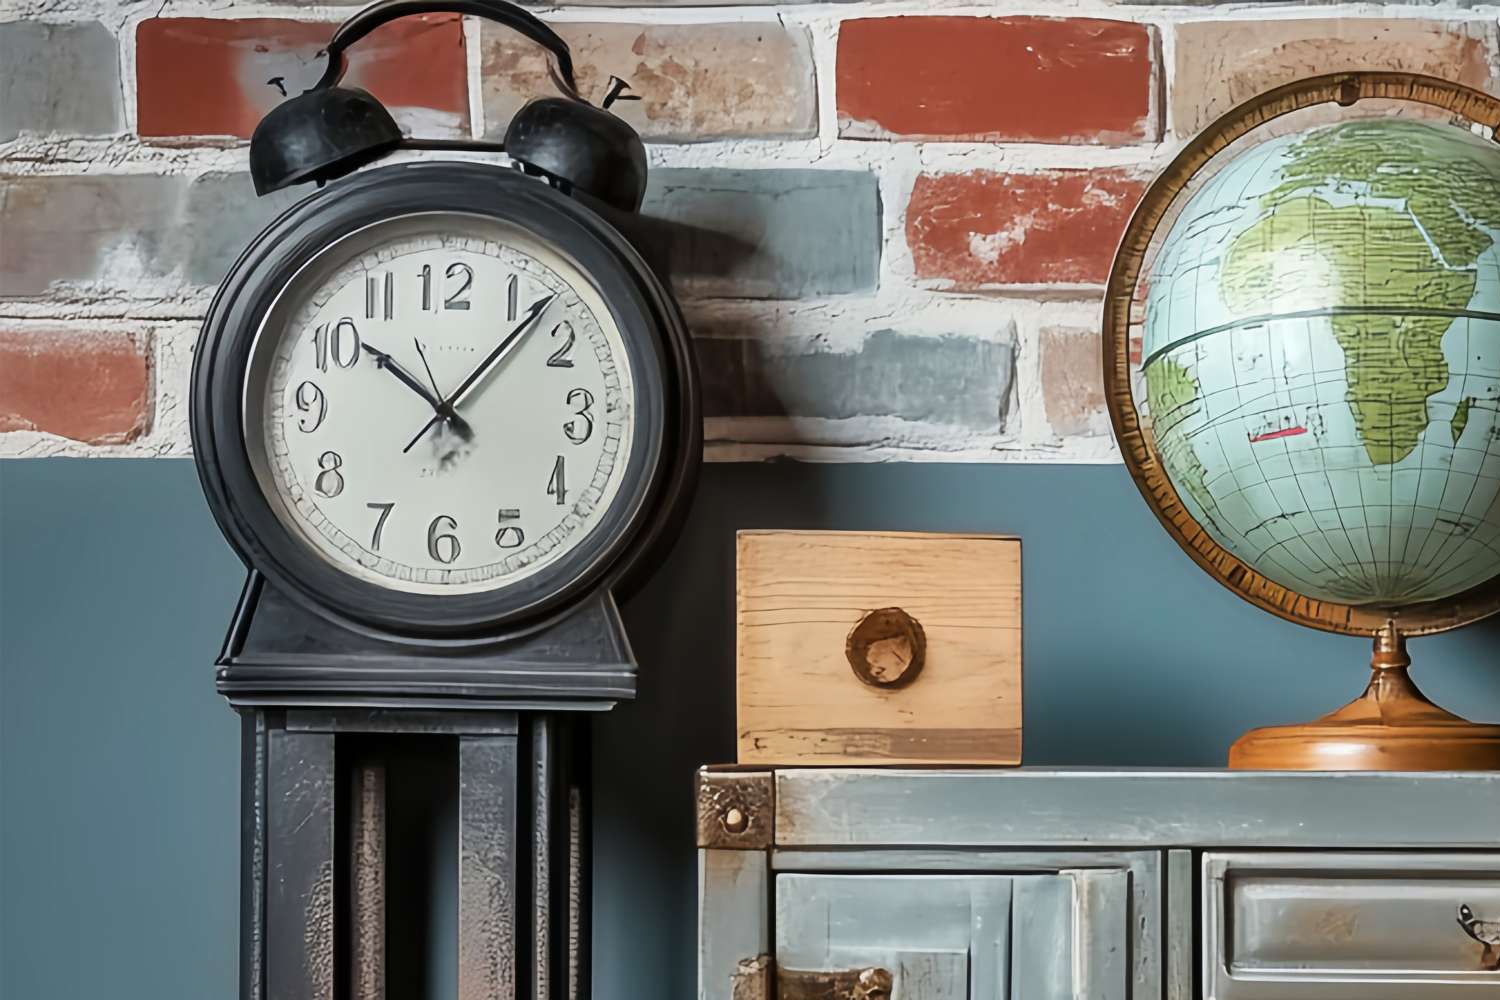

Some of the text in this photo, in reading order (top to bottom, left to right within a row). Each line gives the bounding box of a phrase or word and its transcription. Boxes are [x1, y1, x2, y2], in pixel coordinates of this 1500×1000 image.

[417, 262, 474, 310] 12
[506, 273, 518, 321] 1
[312, 316, 360, 372] 10
[546, 320, 576, 368] 2
[296, 381, 327, 433] 9
[563, 388, 594, 445] 3
[315, 451, 344, 498] 8
[547, 456, 567, 505] 4
[366, 502, 395, 551] 7
[428, 515, 461, 564] 6
